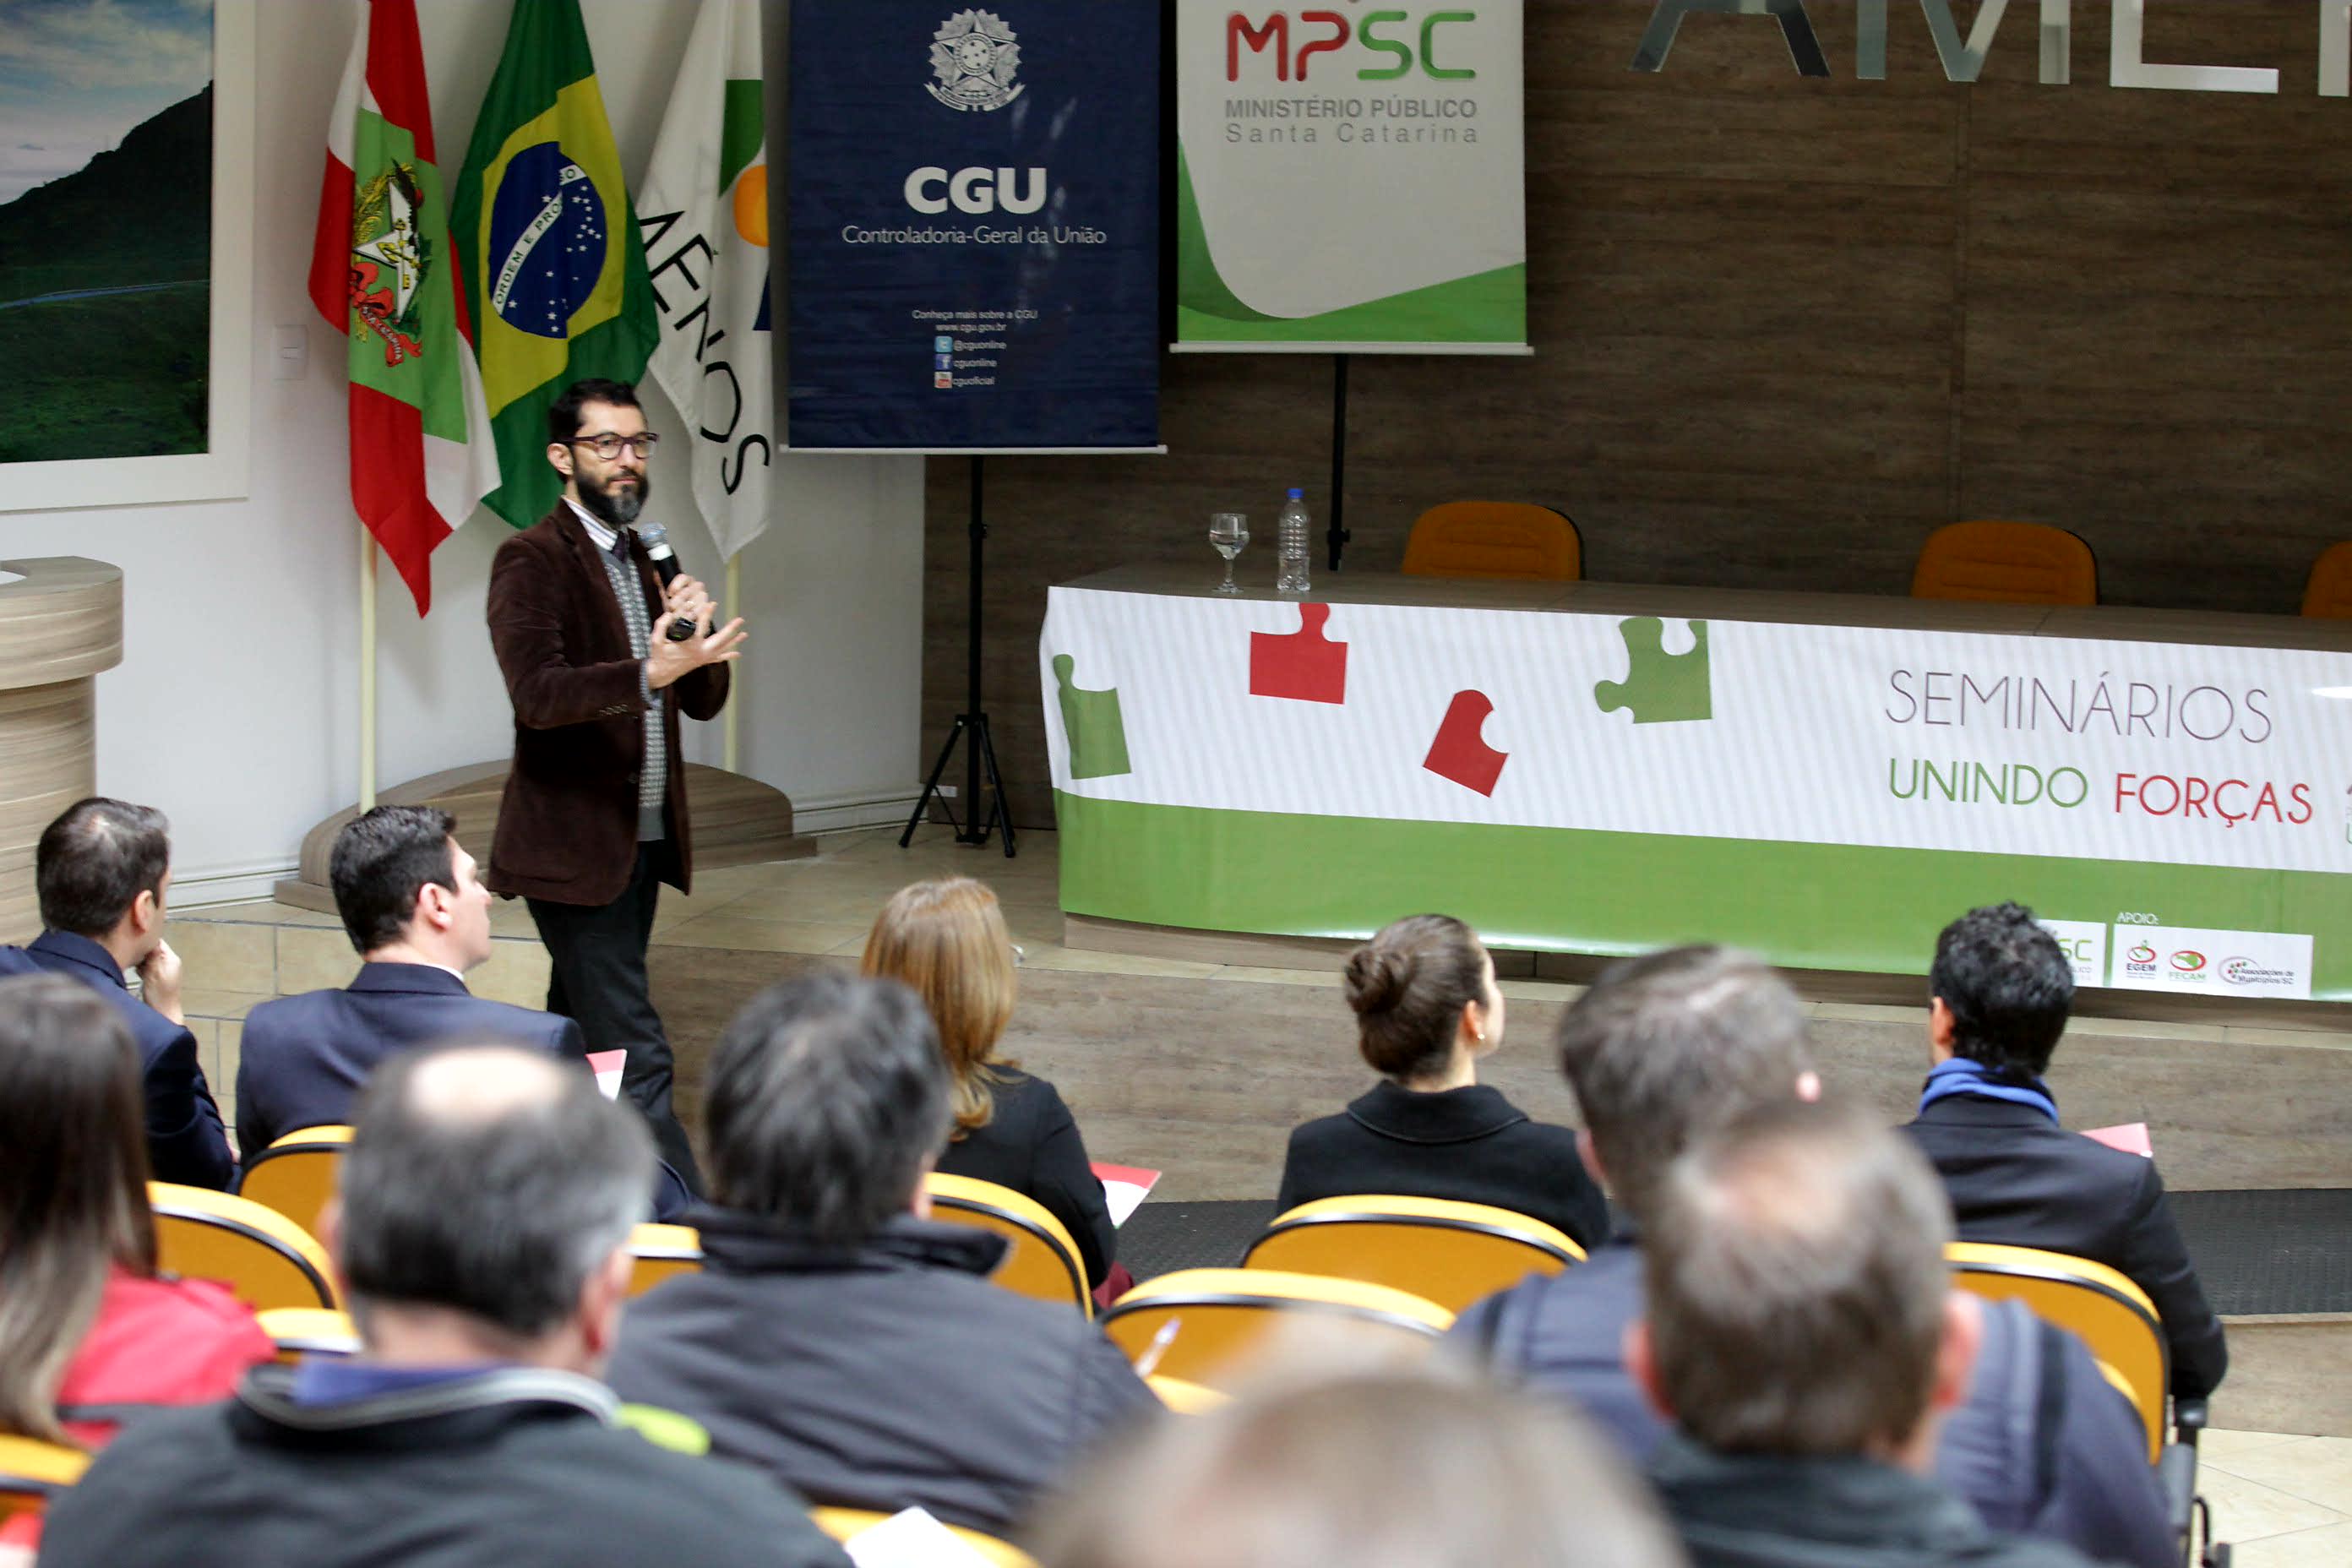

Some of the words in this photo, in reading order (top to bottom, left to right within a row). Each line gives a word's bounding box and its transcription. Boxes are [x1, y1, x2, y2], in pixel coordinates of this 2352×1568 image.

[1227, 11, 1477, 82] MPSC
[1226, 95, 1363, 118] MINISTÉRIO
[1371, 94, 1477, 118] PÚBLICO
[1226, 123, 1317, 143] Santa
[1337, 123, 1478, 143] Catarina
[905, 166, 1047, 214] CGU
[842, 225, 1022, 244] Controladoria-Geral
[1027, 226, 1049, 244] da
[1053, 226, 1108, 244] União
[495, 251, 524, 304] ORDEM
[523, 233, 534, 244] E
[912, 310, 954, 320] Conheça
[956, 310, 977, 318] mais
[979, 310, 1004, 318] sobre
[1015, 309, 1037, 318] CGU
[936, 323, 1006, 333] www.cgu.gov.br
[954, 340, 1006, 351] @cguonline
[1886, 670, 2272, 743] SEMINÁRIOS
[1889, 758, 2088, 808] UNINDO
[2115, 772, 2313, 829] FORÇAS
[2116, 912, 2159, 925] APOIO:
[2126, 962, 2157, 972] EGEM
